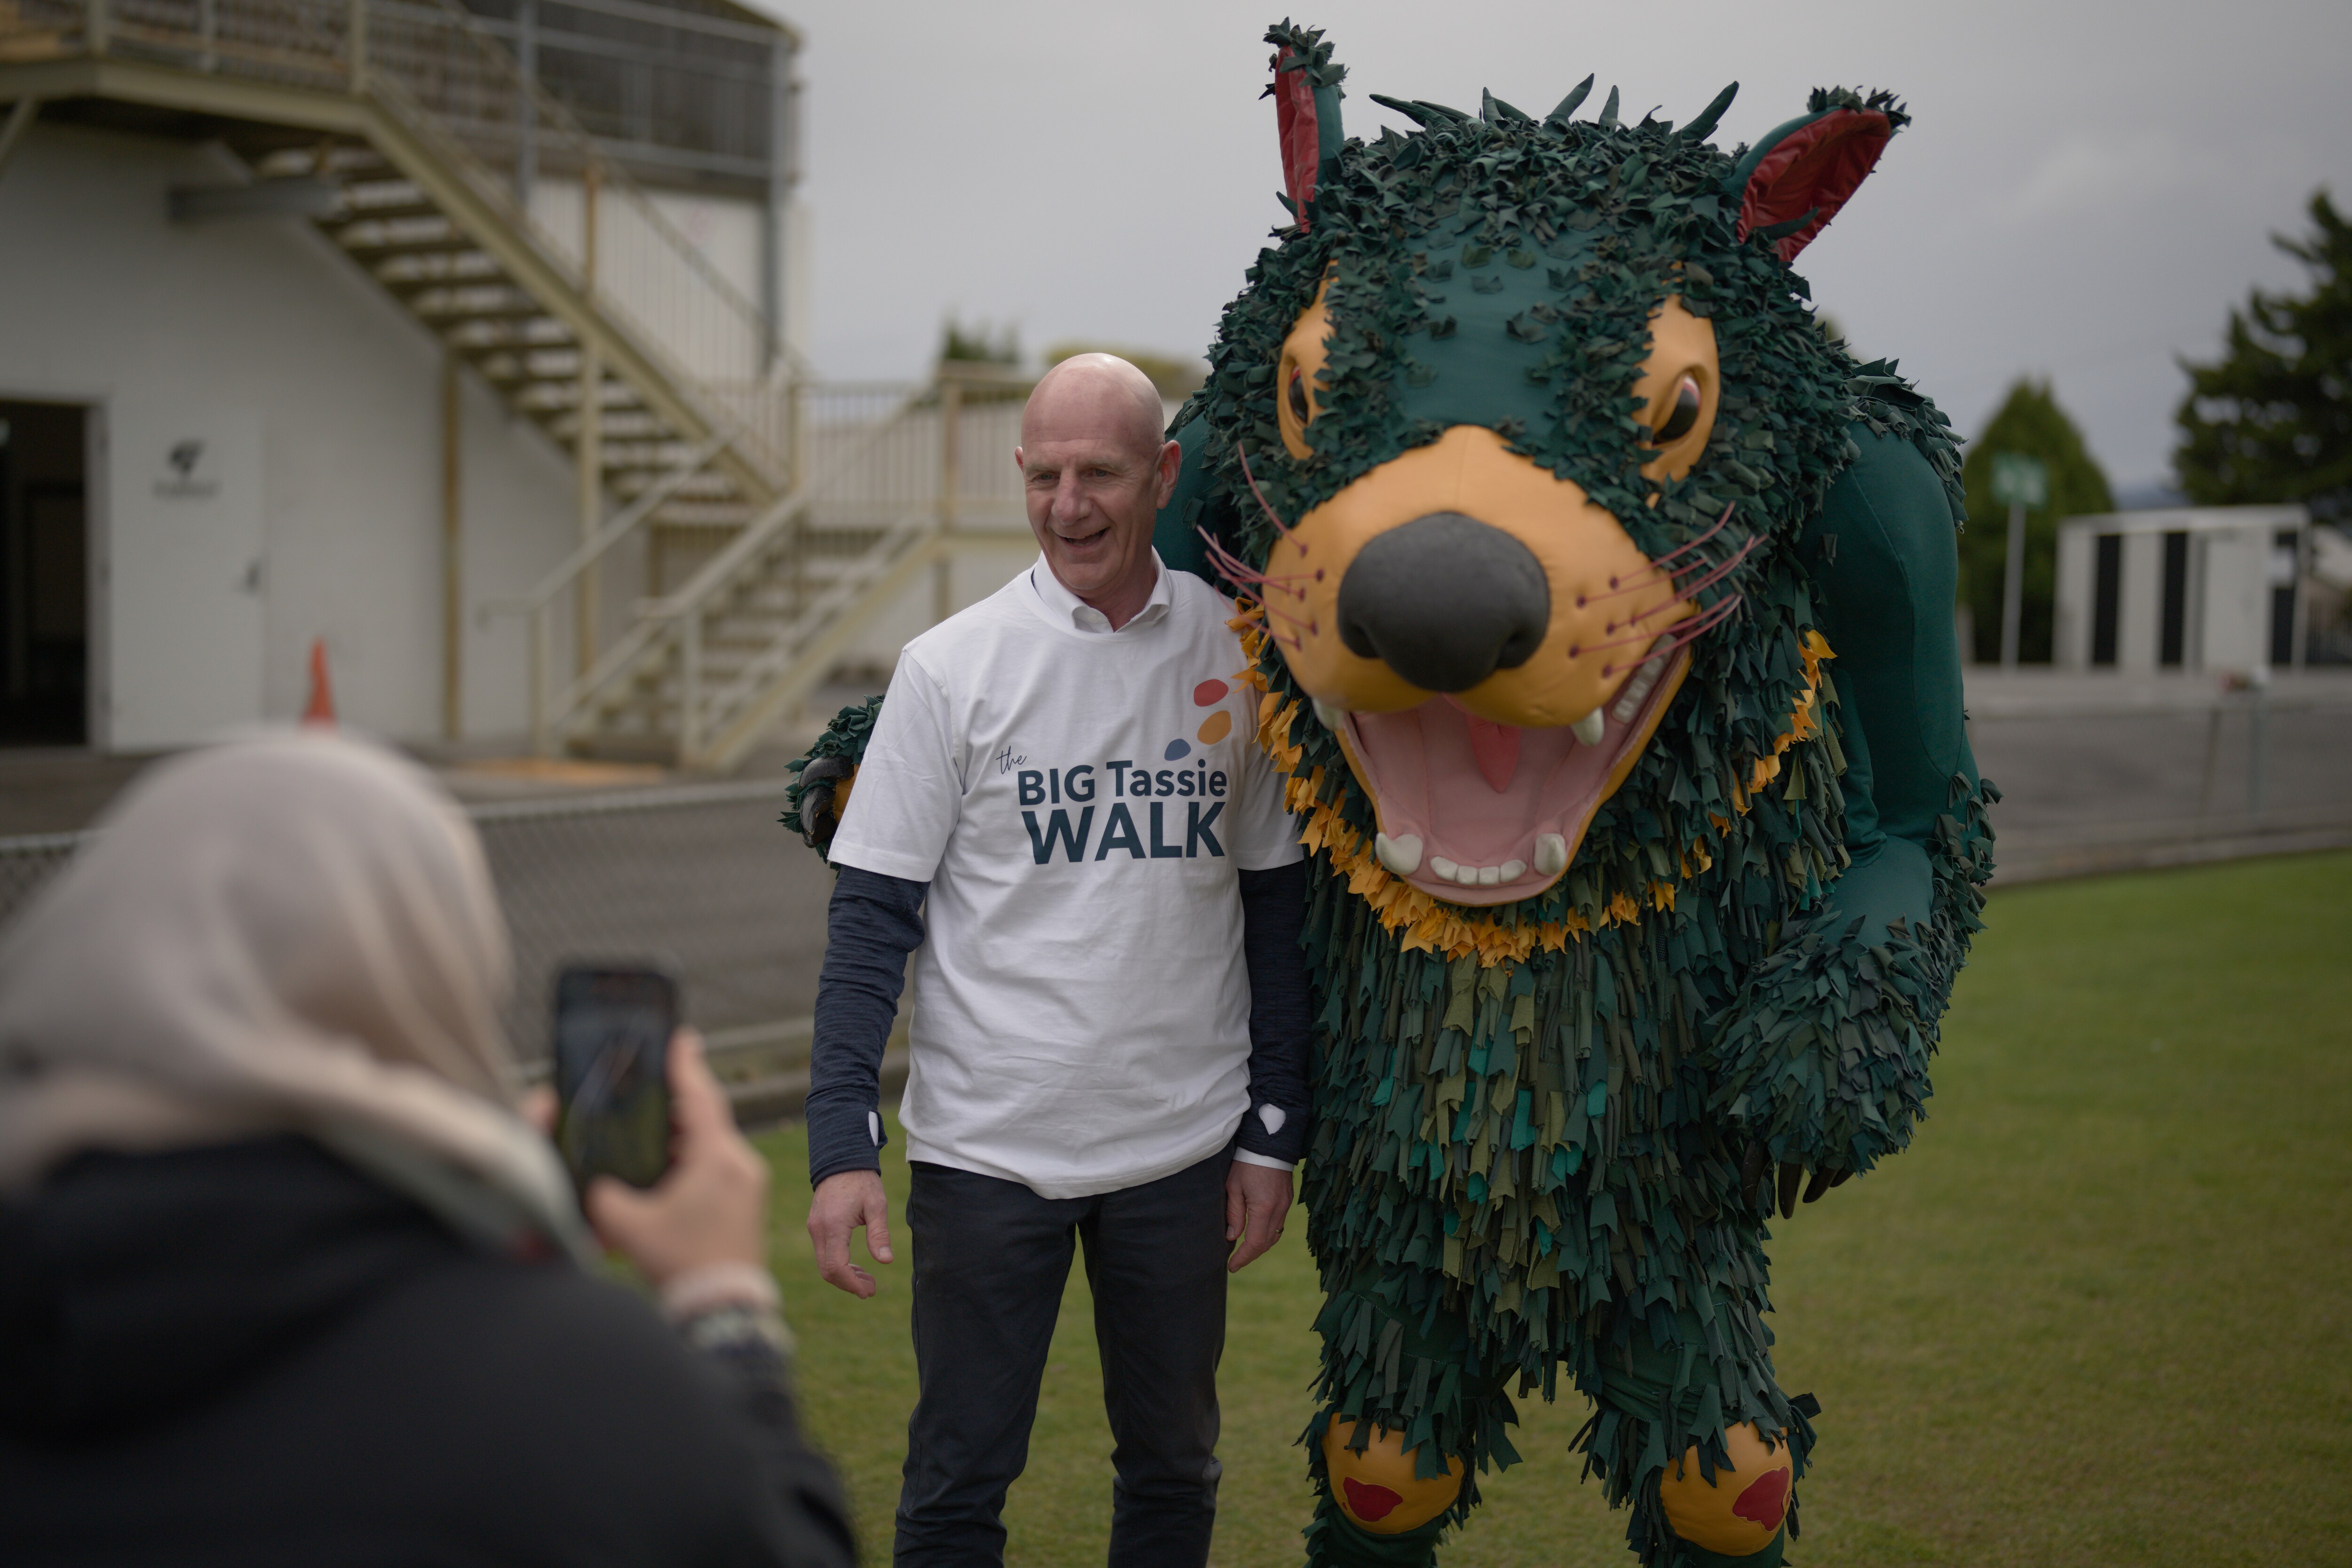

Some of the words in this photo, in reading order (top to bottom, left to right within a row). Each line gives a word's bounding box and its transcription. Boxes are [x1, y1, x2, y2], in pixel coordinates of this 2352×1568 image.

[996, 746, 1027, 774] the
[1017, 764, 1095, 806] BIG
[1106, 759, 1227, 797] Tassie
[1021, 802, 1226, 865] WALK
